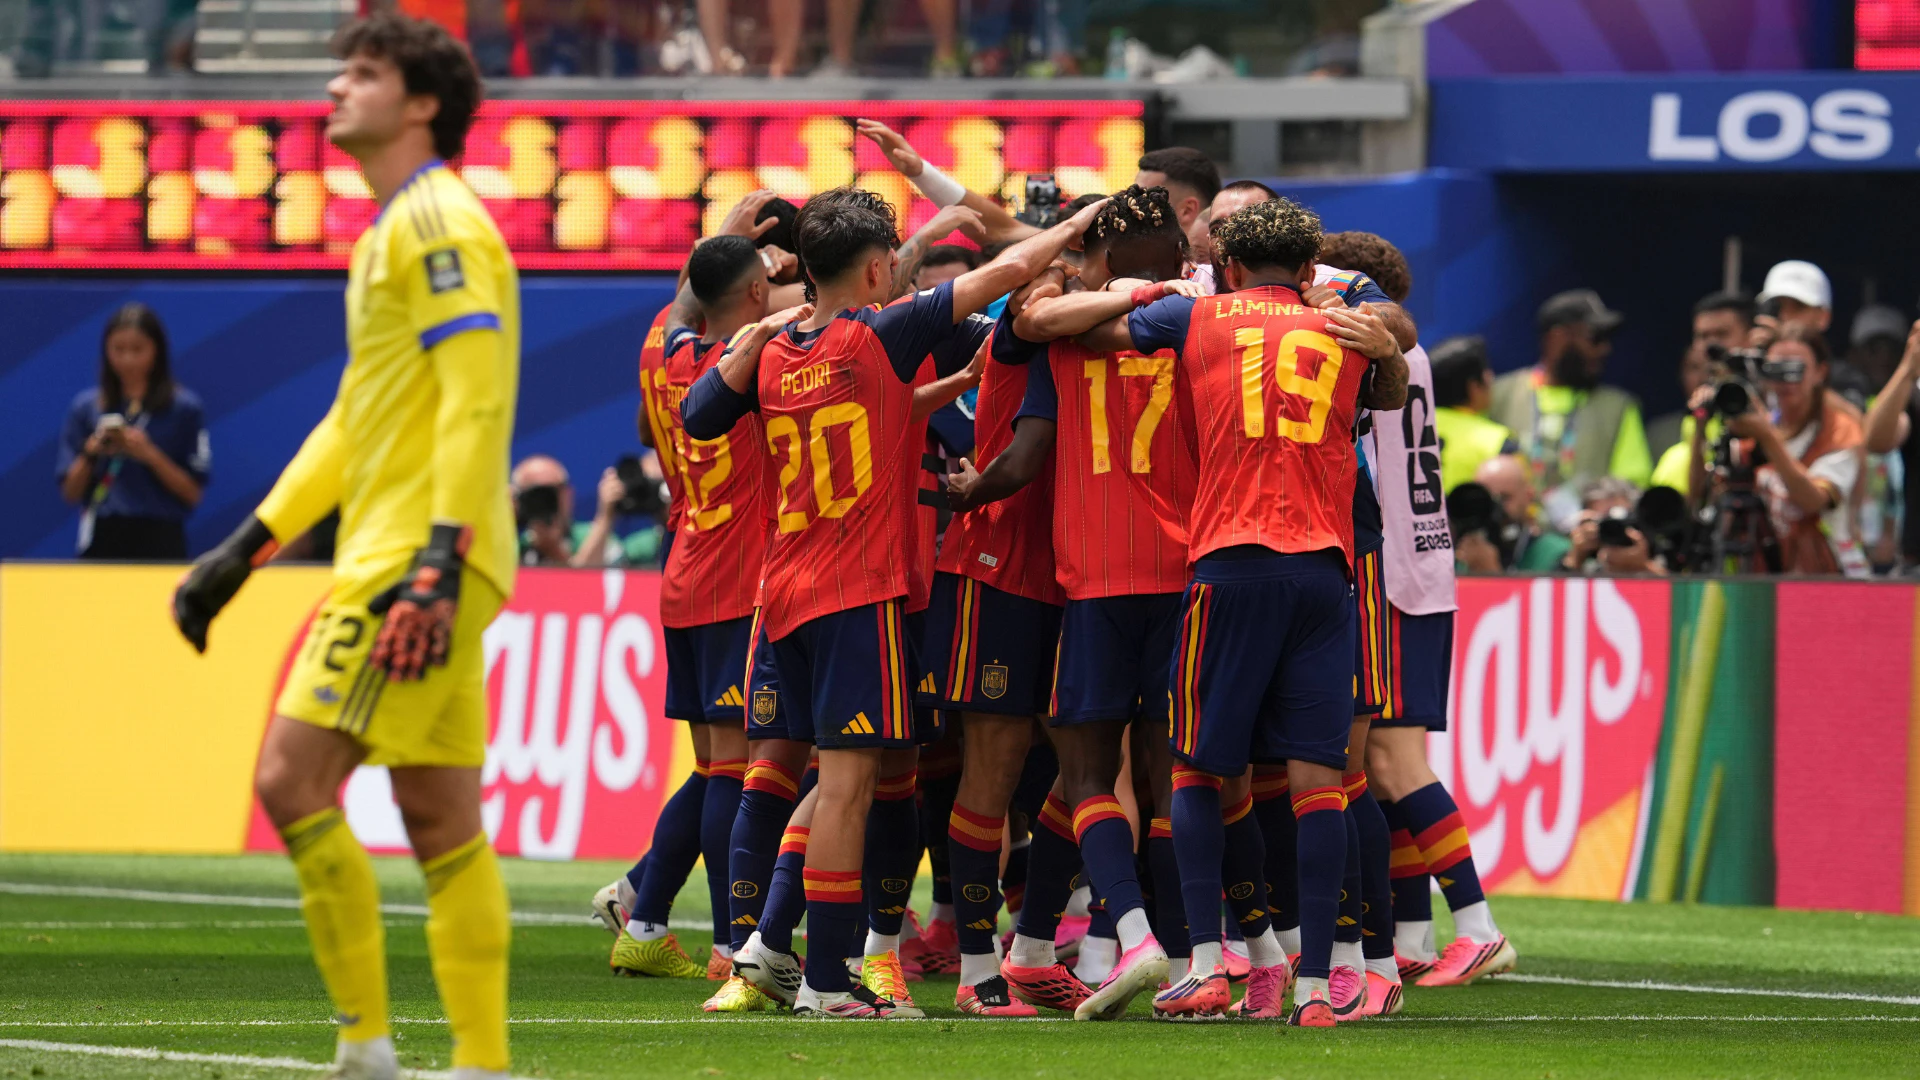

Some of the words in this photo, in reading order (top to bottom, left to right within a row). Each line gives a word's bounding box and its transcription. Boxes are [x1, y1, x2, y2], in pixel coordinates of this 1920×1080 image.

[1648, 88, 1894, 162] LOS
[1215, 299, 1304, 319] LAMINE
[780, 361, 831, 397] PEDRI
[1083, 357, 1175, 475] 17
[1234, 327, 1344, 444] 19
[675, 427, 733, 531] 12
[766, 401, 873, 535] 20
[1413, 489, 1435, 504] FIFA
[1414, 532, 1451, 553] 2026
